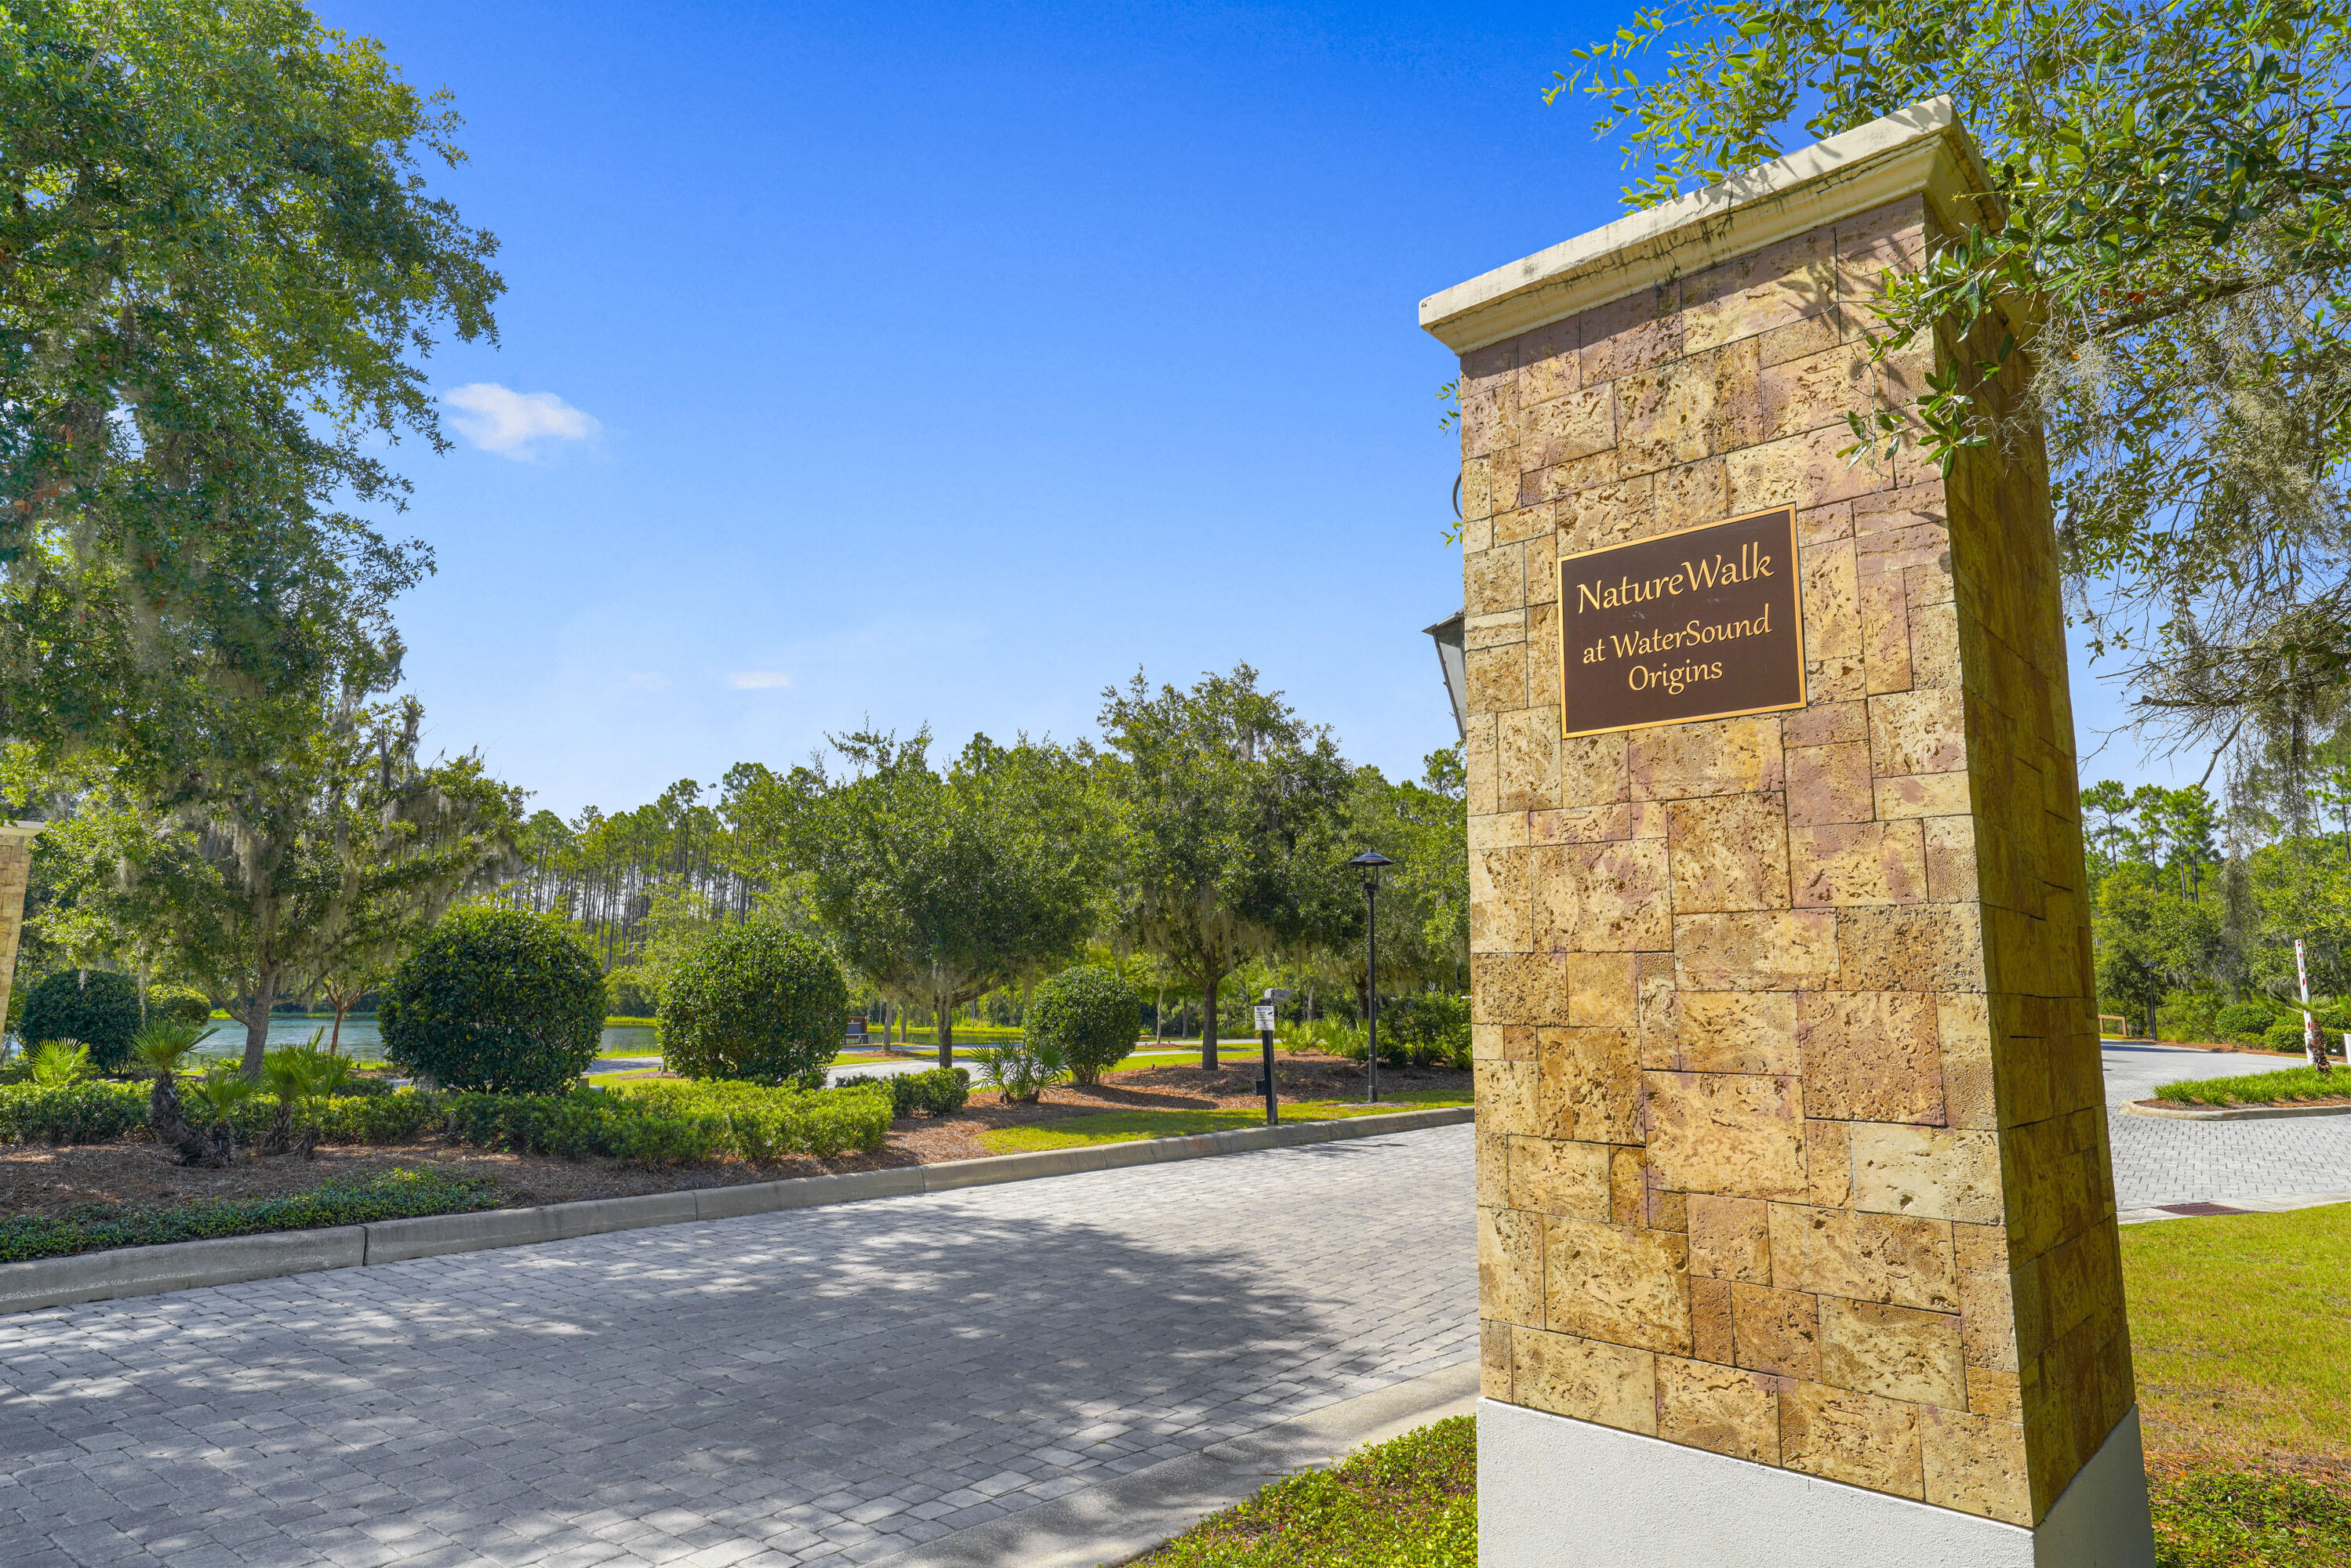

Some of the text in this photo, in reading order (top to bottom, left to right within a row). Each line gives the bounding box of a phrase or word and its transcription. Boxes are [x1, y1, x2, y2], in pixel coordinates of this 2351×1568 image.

[1577, 541, 1775, 613] NatureWalk
[1582, 603, 1772, 664] at WaterSound
[1628, 659, 1723, 695] Origins
